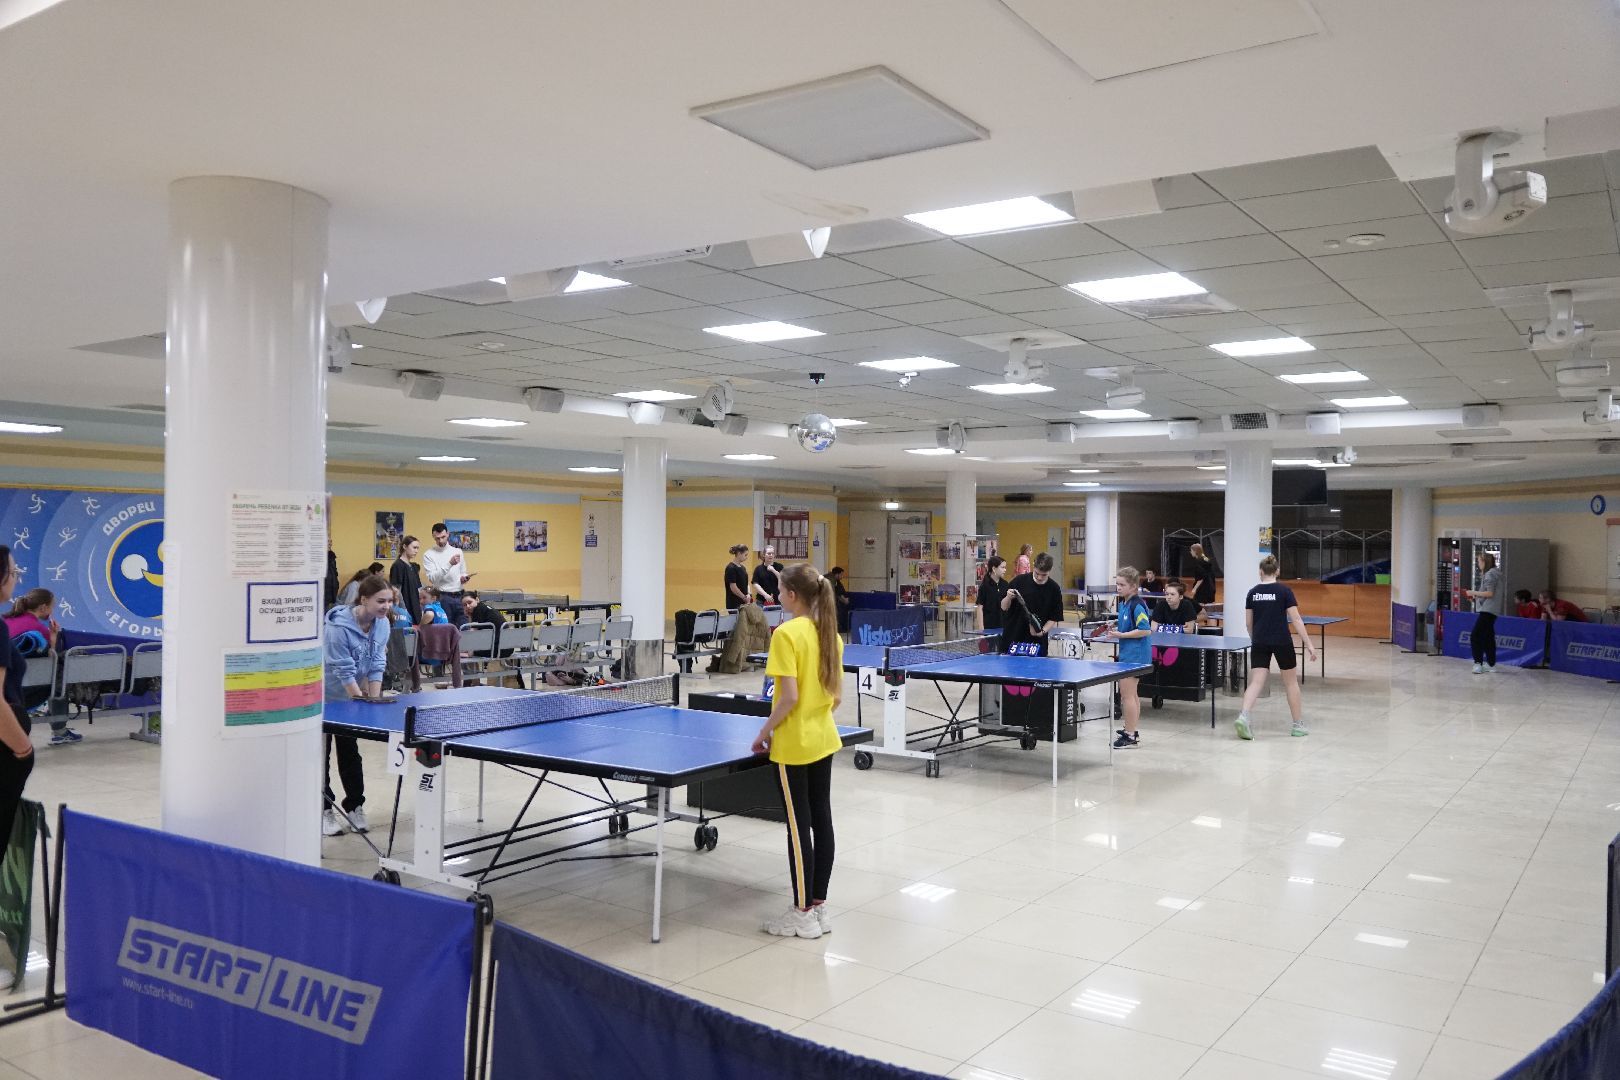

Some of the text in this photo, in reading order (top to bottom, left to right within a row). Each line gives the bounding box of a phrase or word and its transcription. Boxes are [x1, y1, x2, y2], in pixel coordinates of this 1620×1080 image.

[102, 501, 156, 536] ДВОРЕЦ
[276, 616, 287, 624] ДО
[1010, 645, 1017, 653] 5
[1068, 643, 1076, 656] 3
[1500, 638, 1523, 648] LINE
[862, 673, 872, 690] 4
[395, 741, 405, 767] 5
[126, 928, 368, 1032] START LINE
